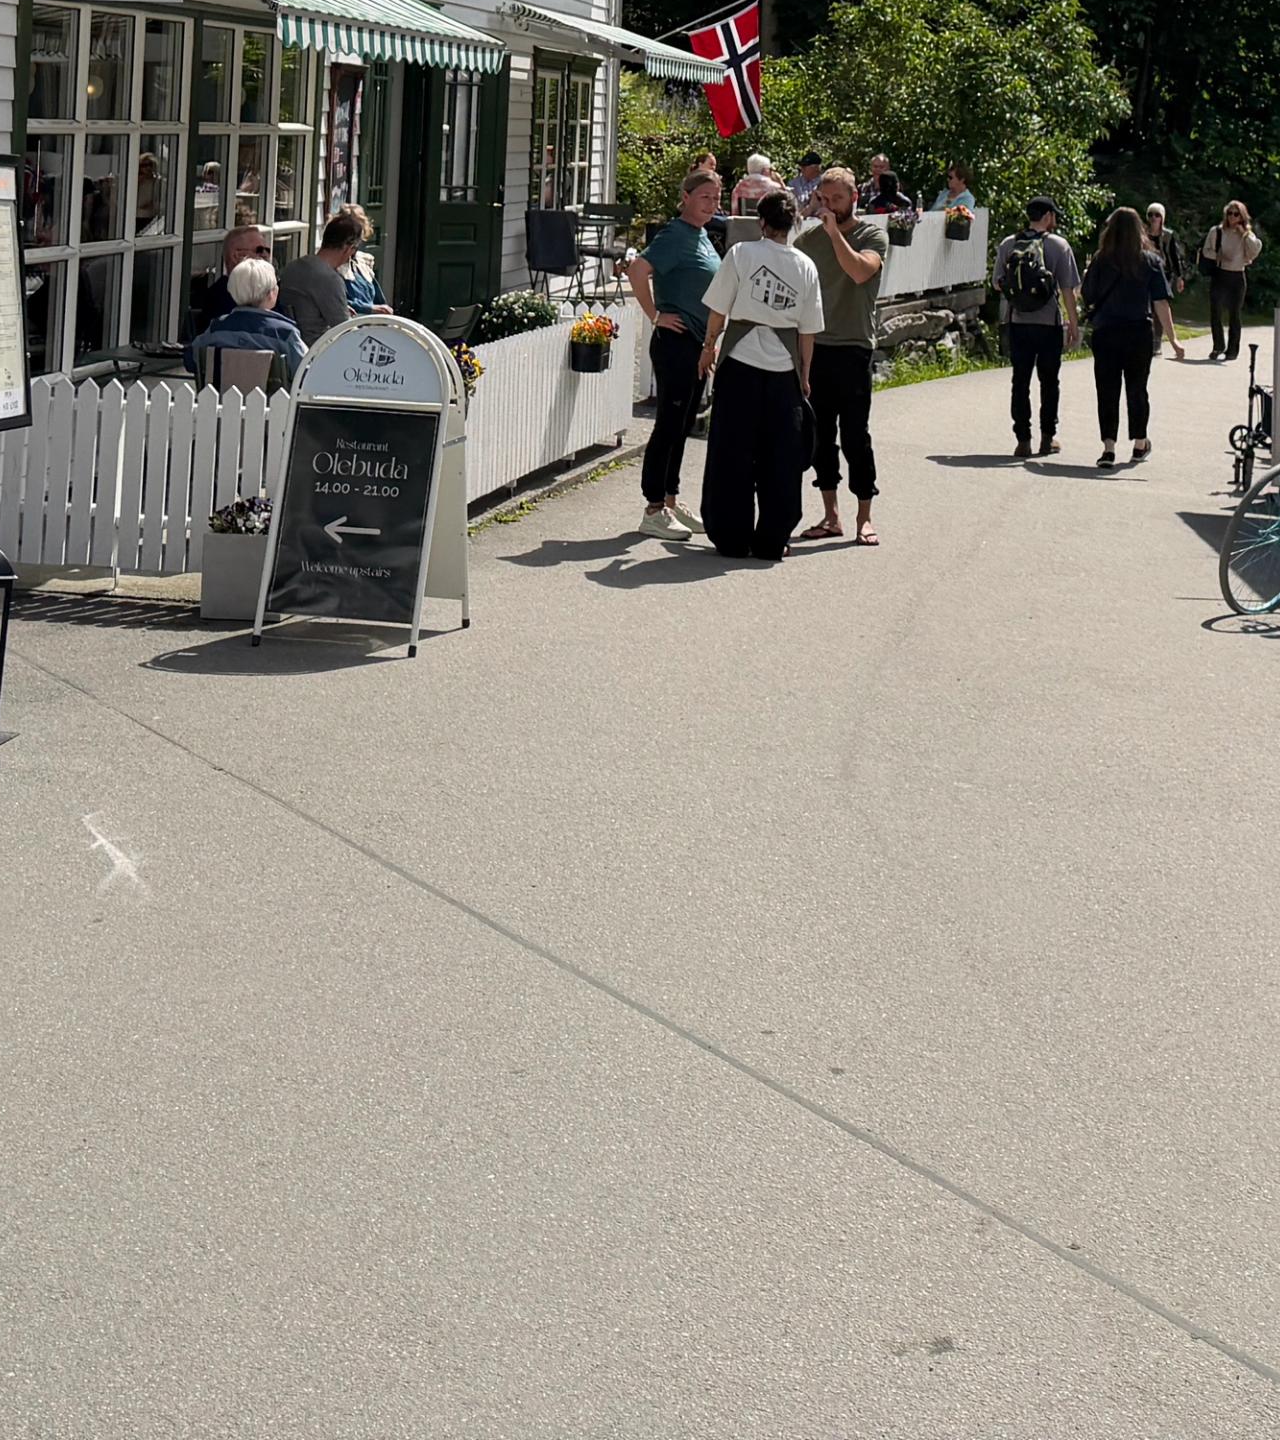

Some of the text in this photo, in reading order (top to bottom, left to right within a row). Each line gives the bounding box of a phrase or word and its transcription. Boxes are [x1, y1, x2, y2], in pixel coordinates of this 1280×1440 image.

[343, 367, 405, 385] Olebuda
[336, 438, 389, 452] Restaurant
[312, 451, 408, 479] Olebuda
[314, 481, 350, 494] 14.00
[363, 484, 400, 497] 21.00
[301, 560, 392, 579] Welcome upstairs
